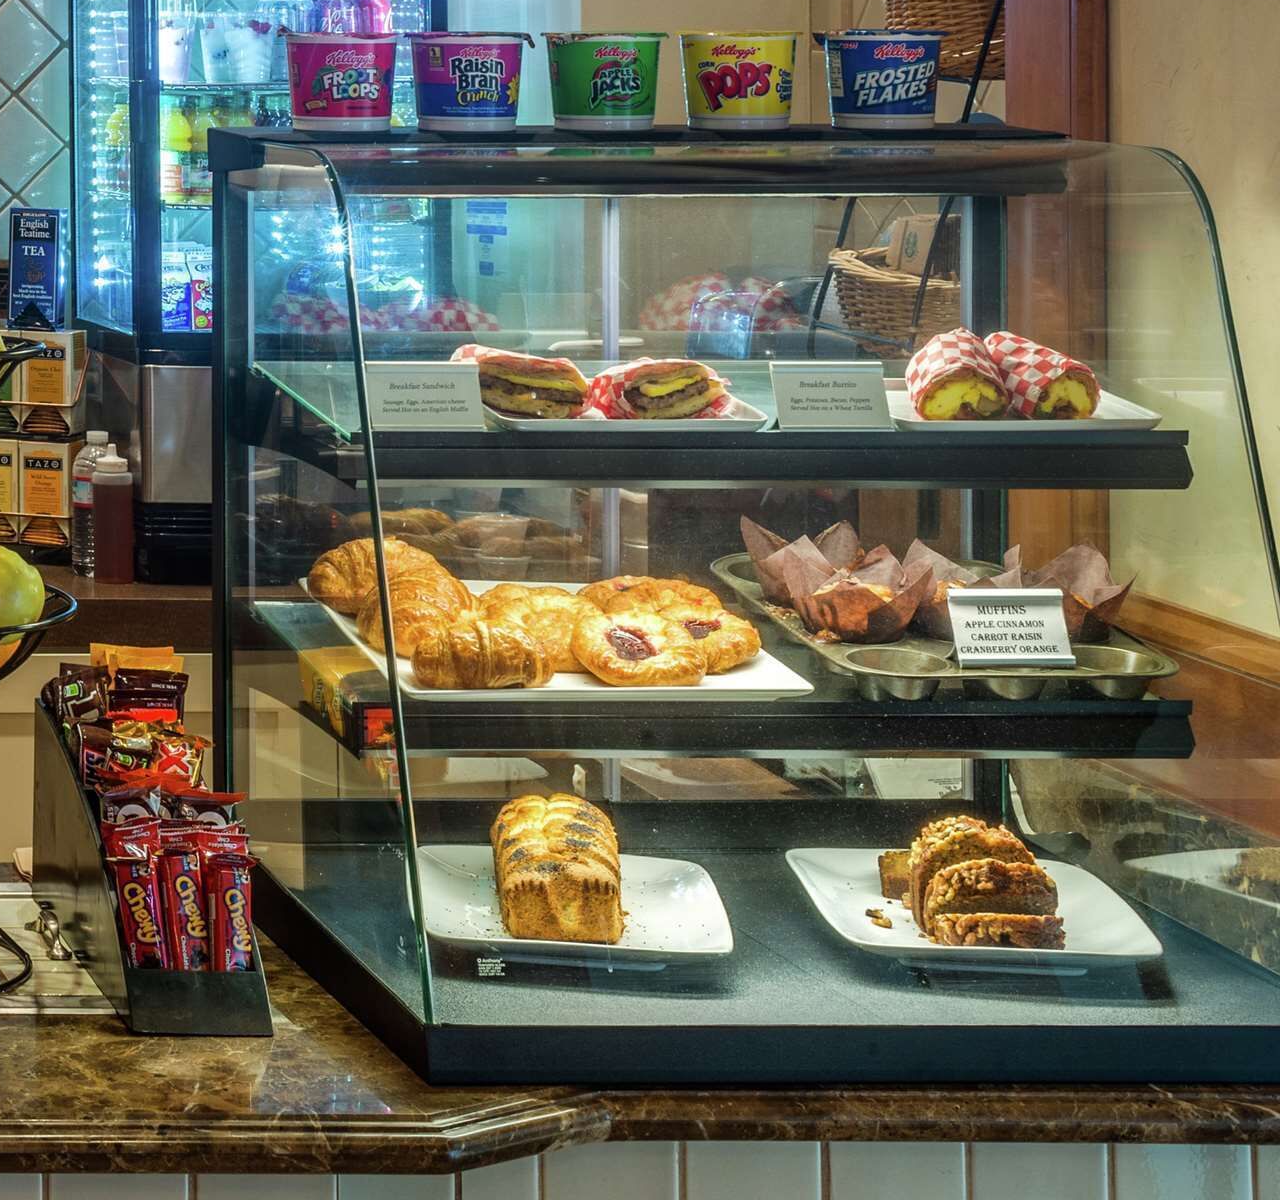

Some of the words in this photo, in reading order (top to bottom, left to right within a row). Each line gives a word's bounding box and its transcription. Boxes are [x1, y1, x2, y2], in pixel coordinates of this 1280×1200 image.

[450, 56, 505, 78] Raisin
[599, 67, 634, 79] APPLE
[323, 68, 377, 90] FROOT
[457, 74, 500, 92] Bran
[854, 61, 936, 92] FROSTED
[332, 83, 380, 101] LOOPS
[590, 77, 641, 110] JACKS
[698, 61, 773, 112] POPS
[856, 79, 928, 108] FLAKES
[457, 89, 500, 106] Crunch
[20, 218, 49, 230] English
[22, 245, 46, 256] TEA
[422, 381, 456, 390] Sandwich
[27, 459, 60, 469] TAZO
[977, 605, 1027, 615] MUFFINS
[964, 620, 995, 629] APPLE
[996, 619, 1045, 629] CINNAMON
[970, 632, 1008, 641] CARROT
[1011, 632, 1043, 641] RAISIN
[960, 644, 1017, 654] CRANBERRY
[1019, 644, 1059, 653] ORANGE
[123, 881, 161, 944] Chewy
[175, 875, 208, 939] Chewy
[224, 888, 253, 952] Chewy
